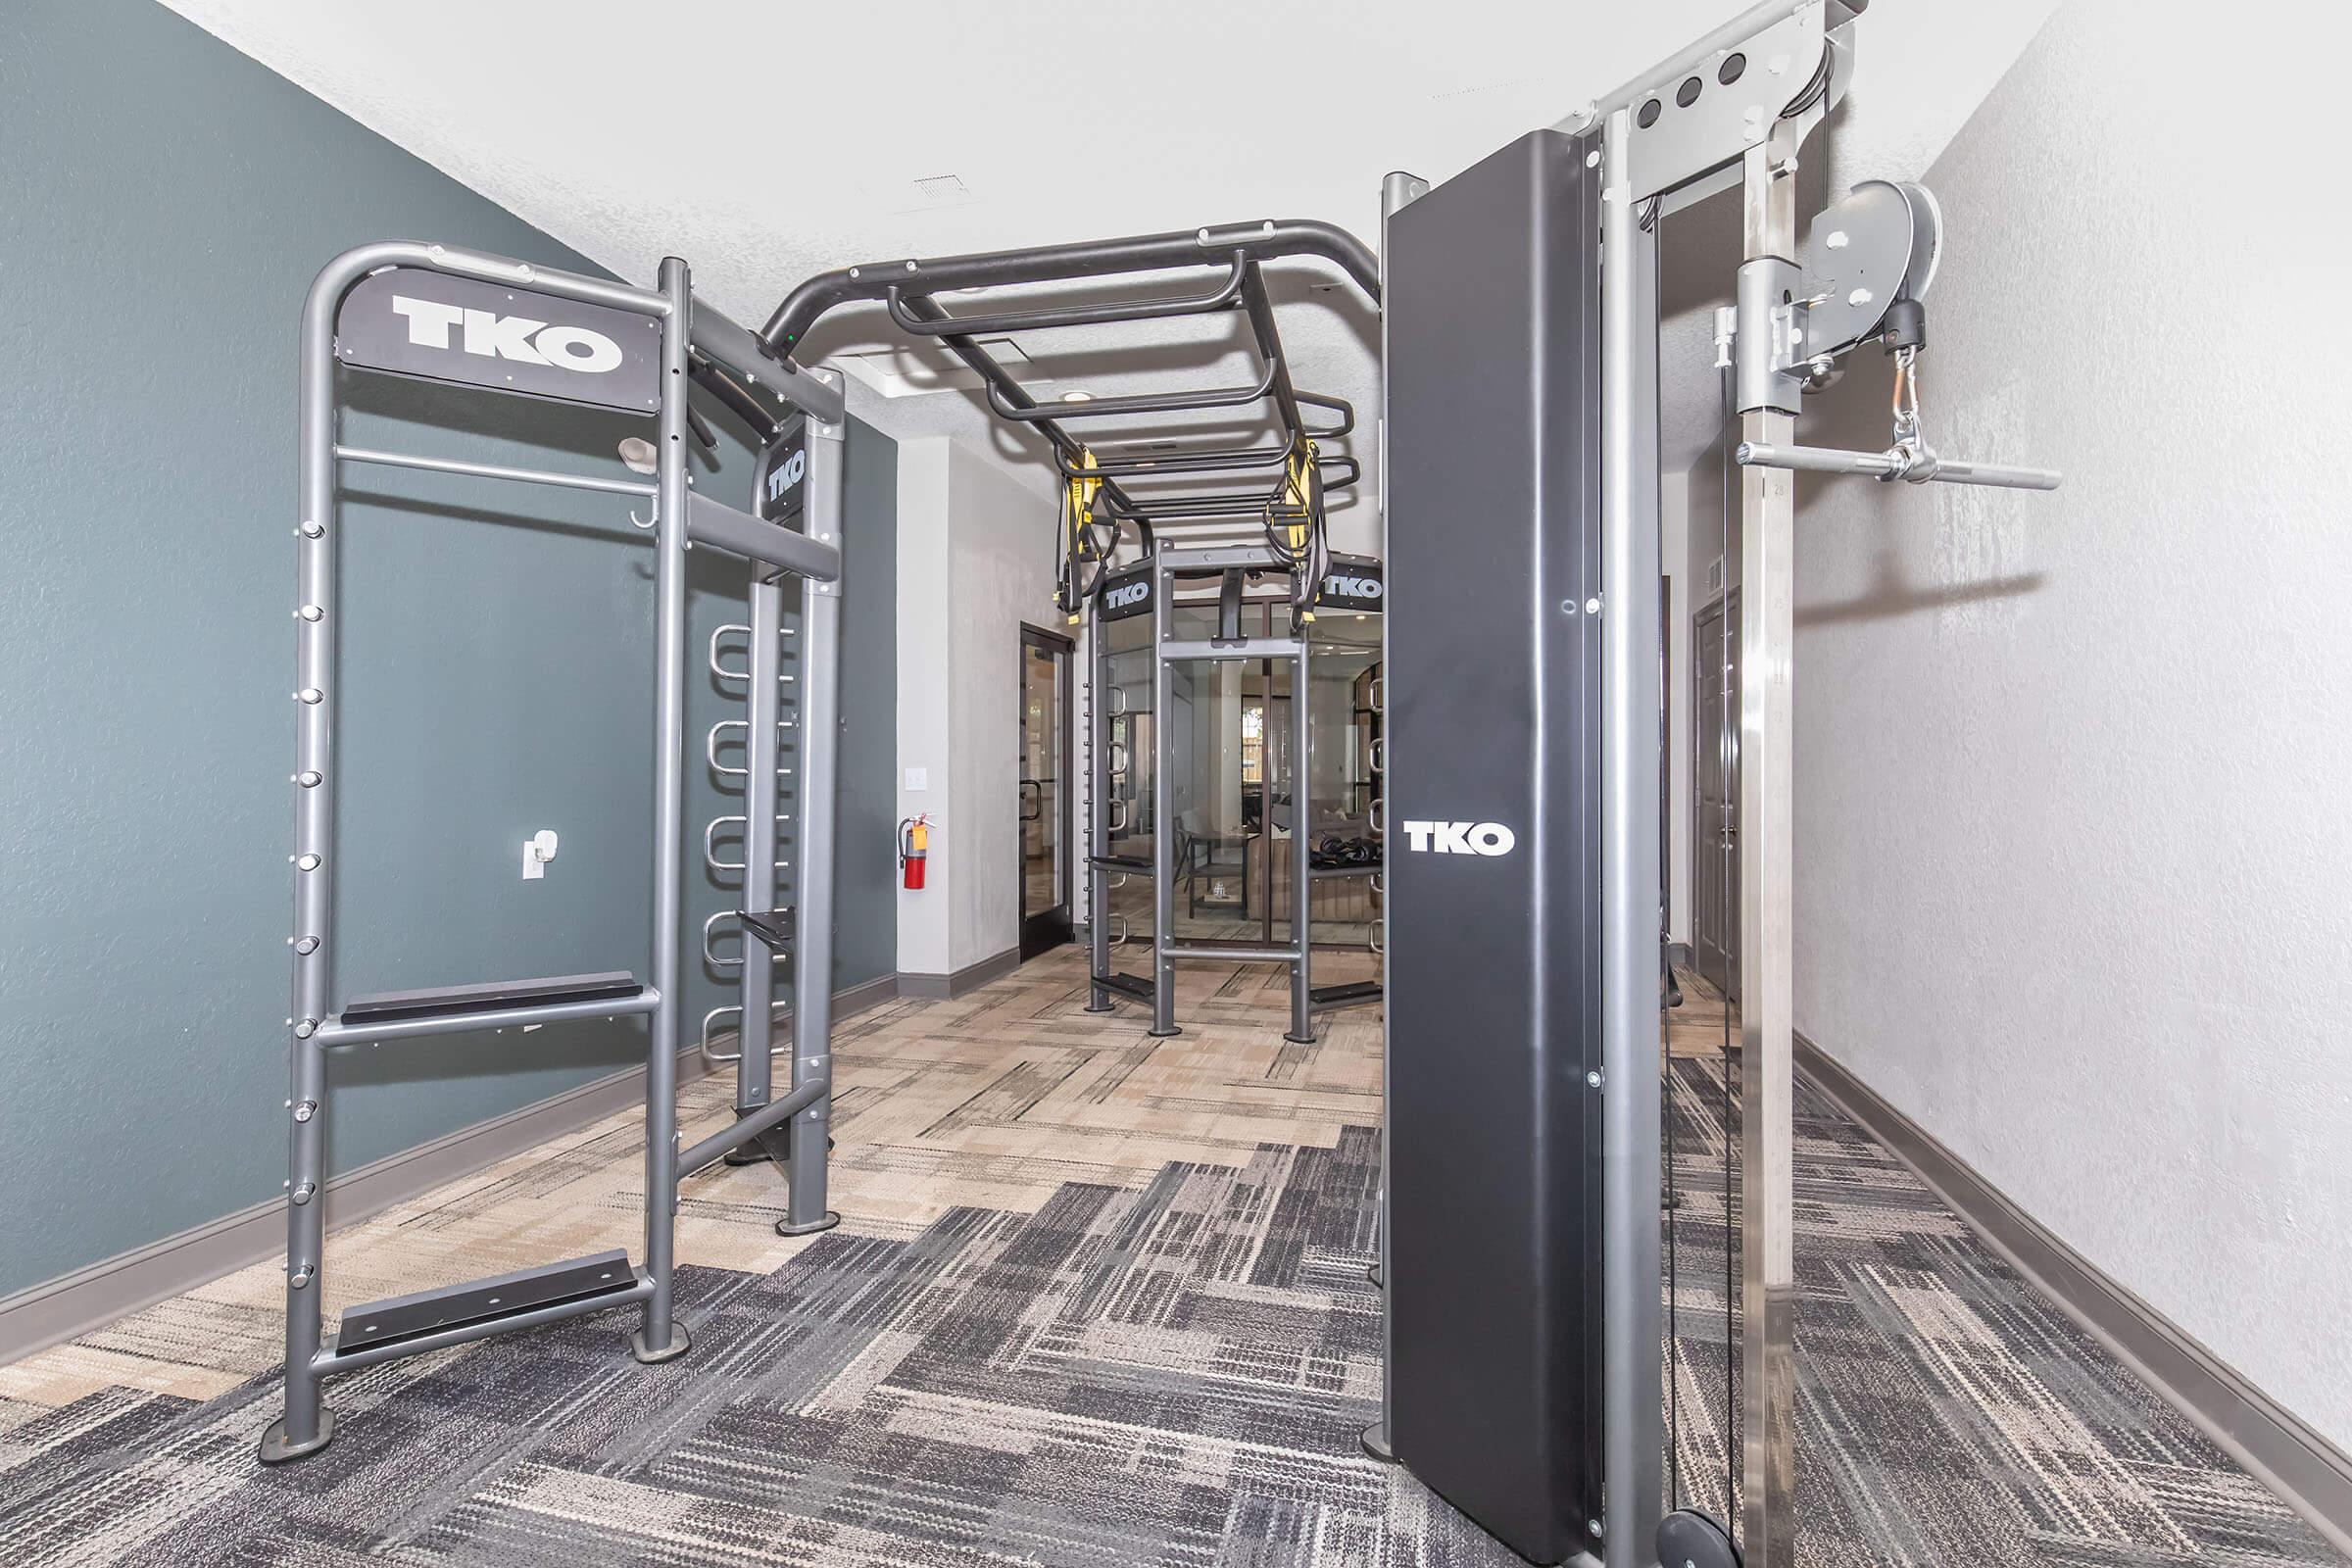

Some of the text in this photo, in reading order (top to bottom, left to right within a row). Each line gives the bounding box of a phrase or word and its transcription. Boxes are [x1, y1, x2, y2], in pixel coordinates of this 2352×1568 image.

[392, 294, 623, 373] TKO
[768, 449, 806, 502] TKO
[1105, 581, 1150, 610] TKO
[1324, 574, 1383, 599] TKO
[1402, 820, 1515, 857] TKO
